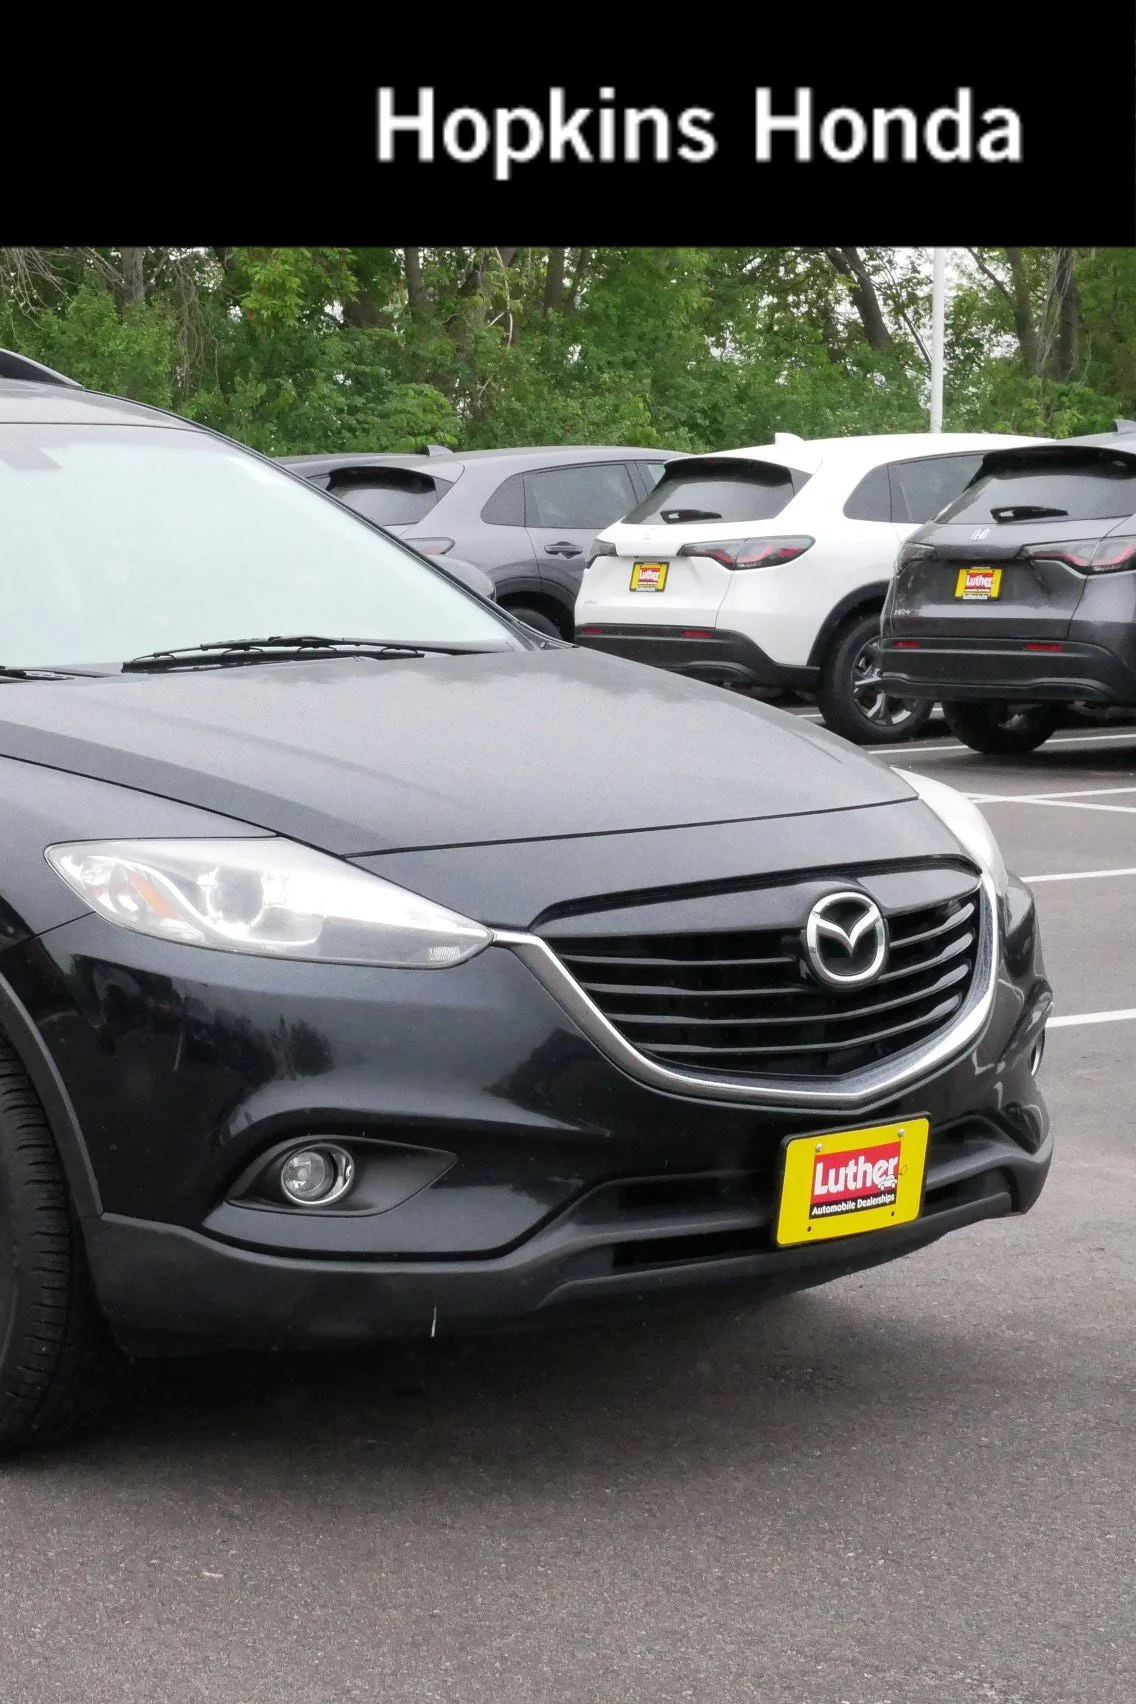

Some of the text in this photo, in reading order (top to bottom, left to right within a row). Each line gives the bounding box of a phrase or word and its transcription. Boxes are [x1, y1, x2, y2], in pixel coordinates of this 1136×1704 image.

[965, 574, 993, 588] Luther
[814, 1155, 899, 1195] Luther
[811, 1193, 895, 1216] Automobile Dealerships
